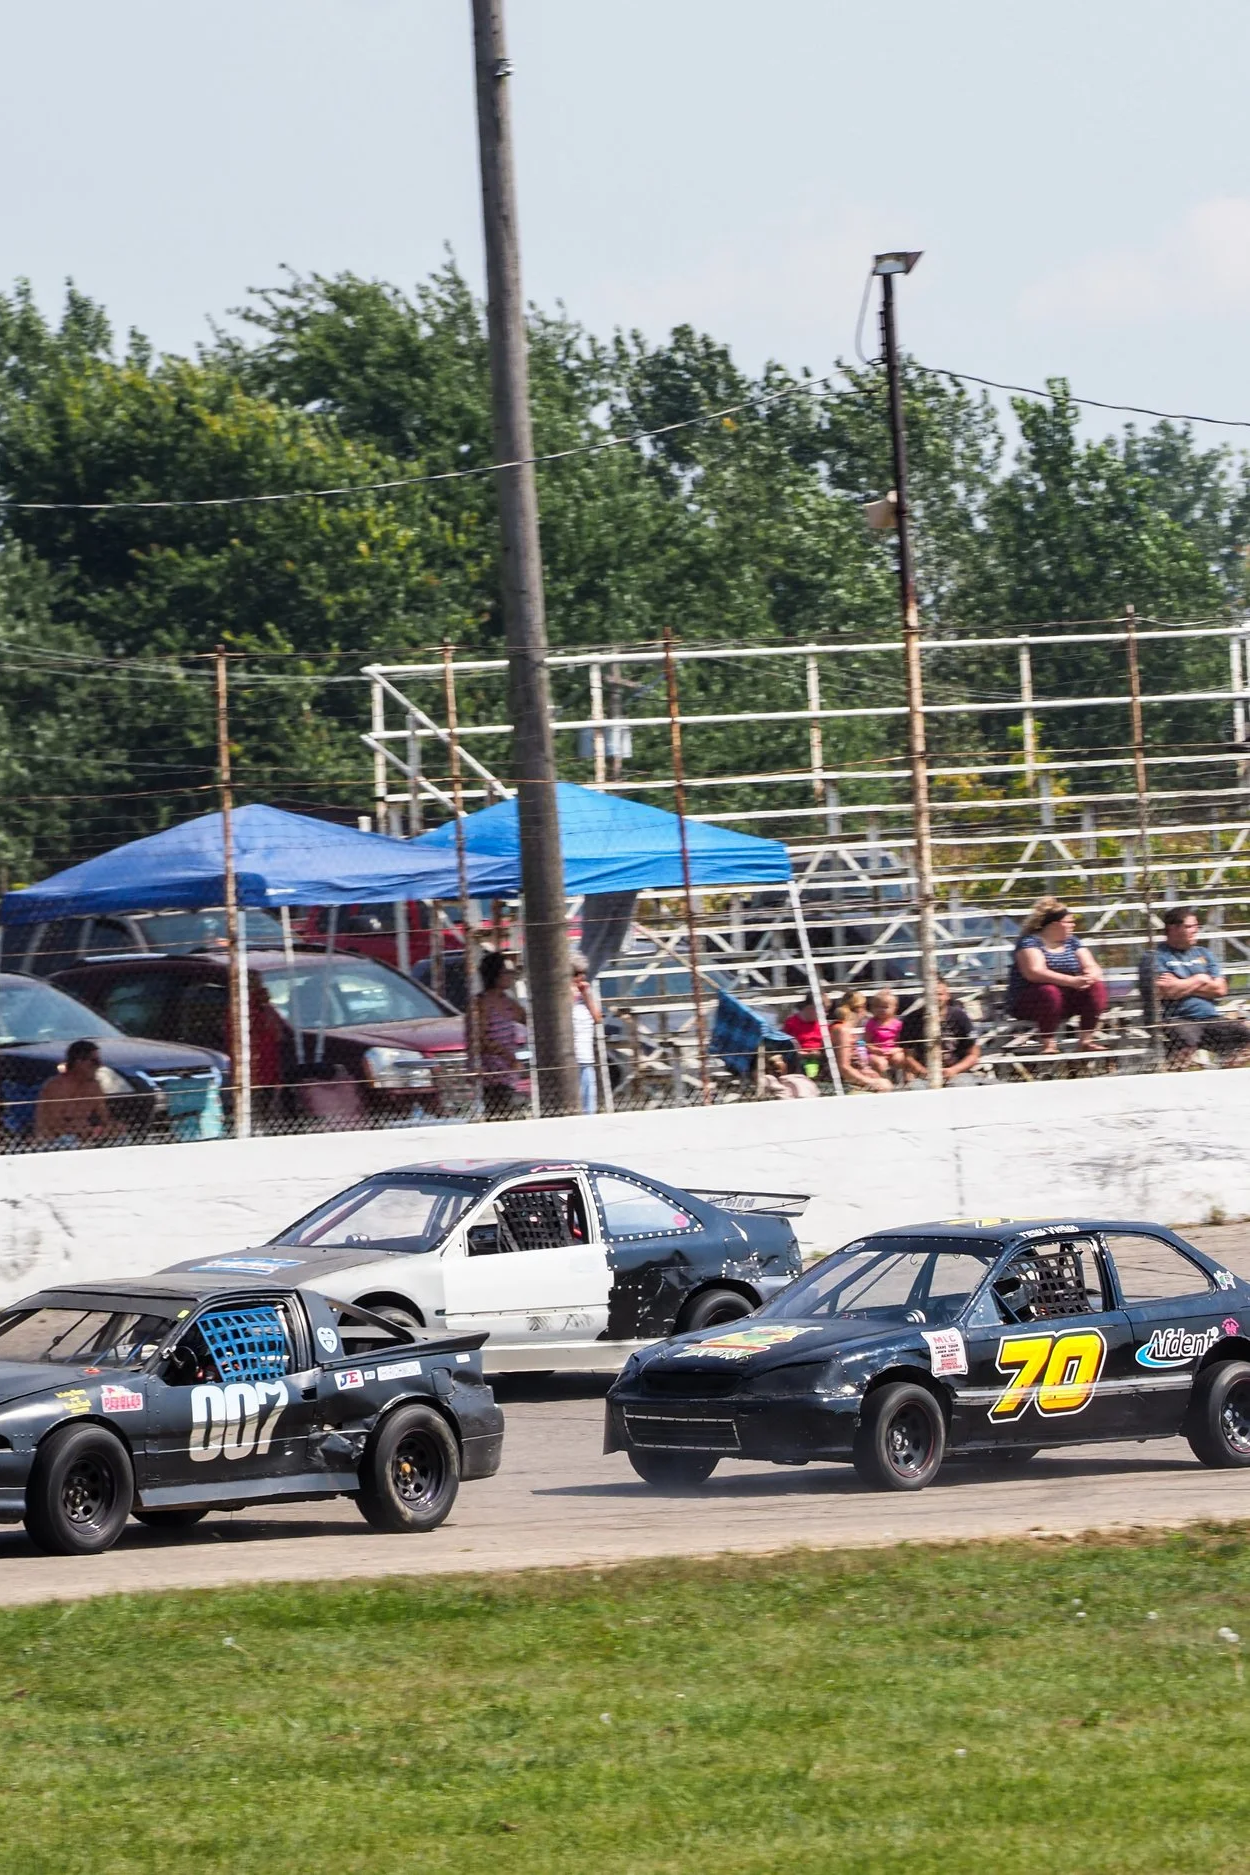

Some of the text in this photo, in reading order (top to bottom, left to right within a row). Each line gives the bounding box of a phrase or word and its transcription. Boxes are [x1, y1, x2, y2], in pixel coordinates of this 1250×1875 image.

[1146, 1328, 1217, 1358] Afdent
[340, 1371, 359, 1387] JE
[987, 1327, 1107, 1424] 70
[189, 1380, 289, 1462] 007
